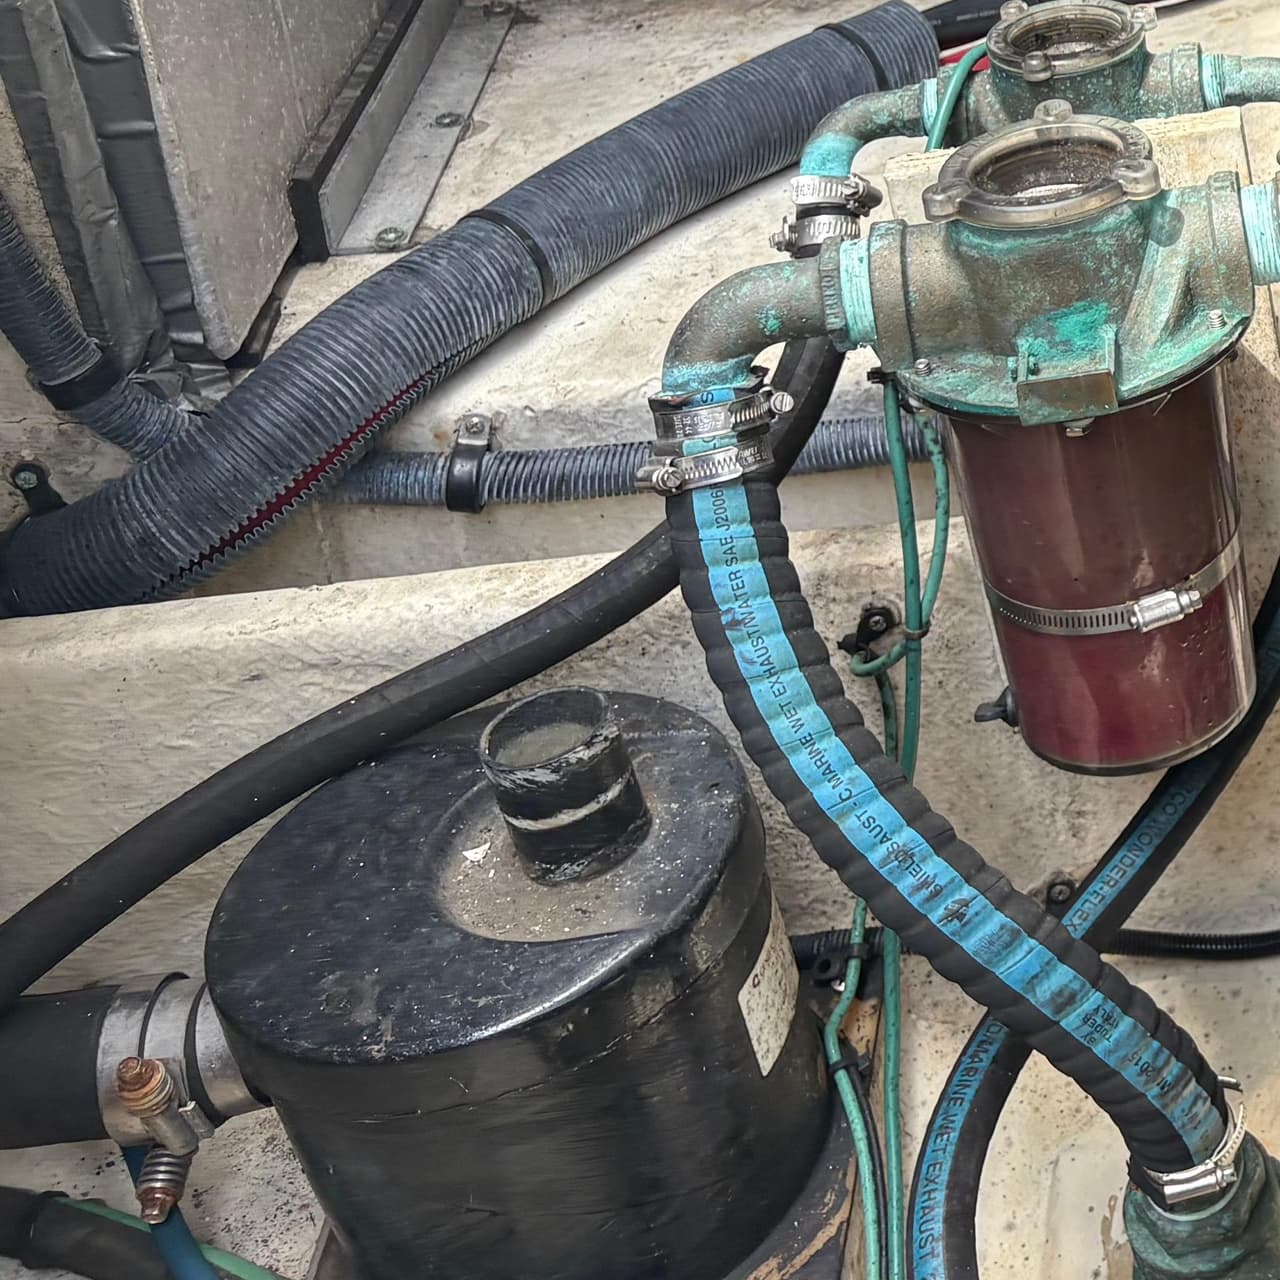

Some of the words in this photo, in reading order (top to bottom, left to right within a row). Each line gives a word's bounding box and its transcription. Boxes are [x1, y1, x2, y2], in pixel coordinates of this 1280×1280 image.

[720, 535, 739, 567] SAE
[778, 696, 804, 732] WET
[801, 734, 844, 789] MARINE
[930, 1113, 957, 1156] WET
[918, 1162, 943, 1259] EXHAUST
